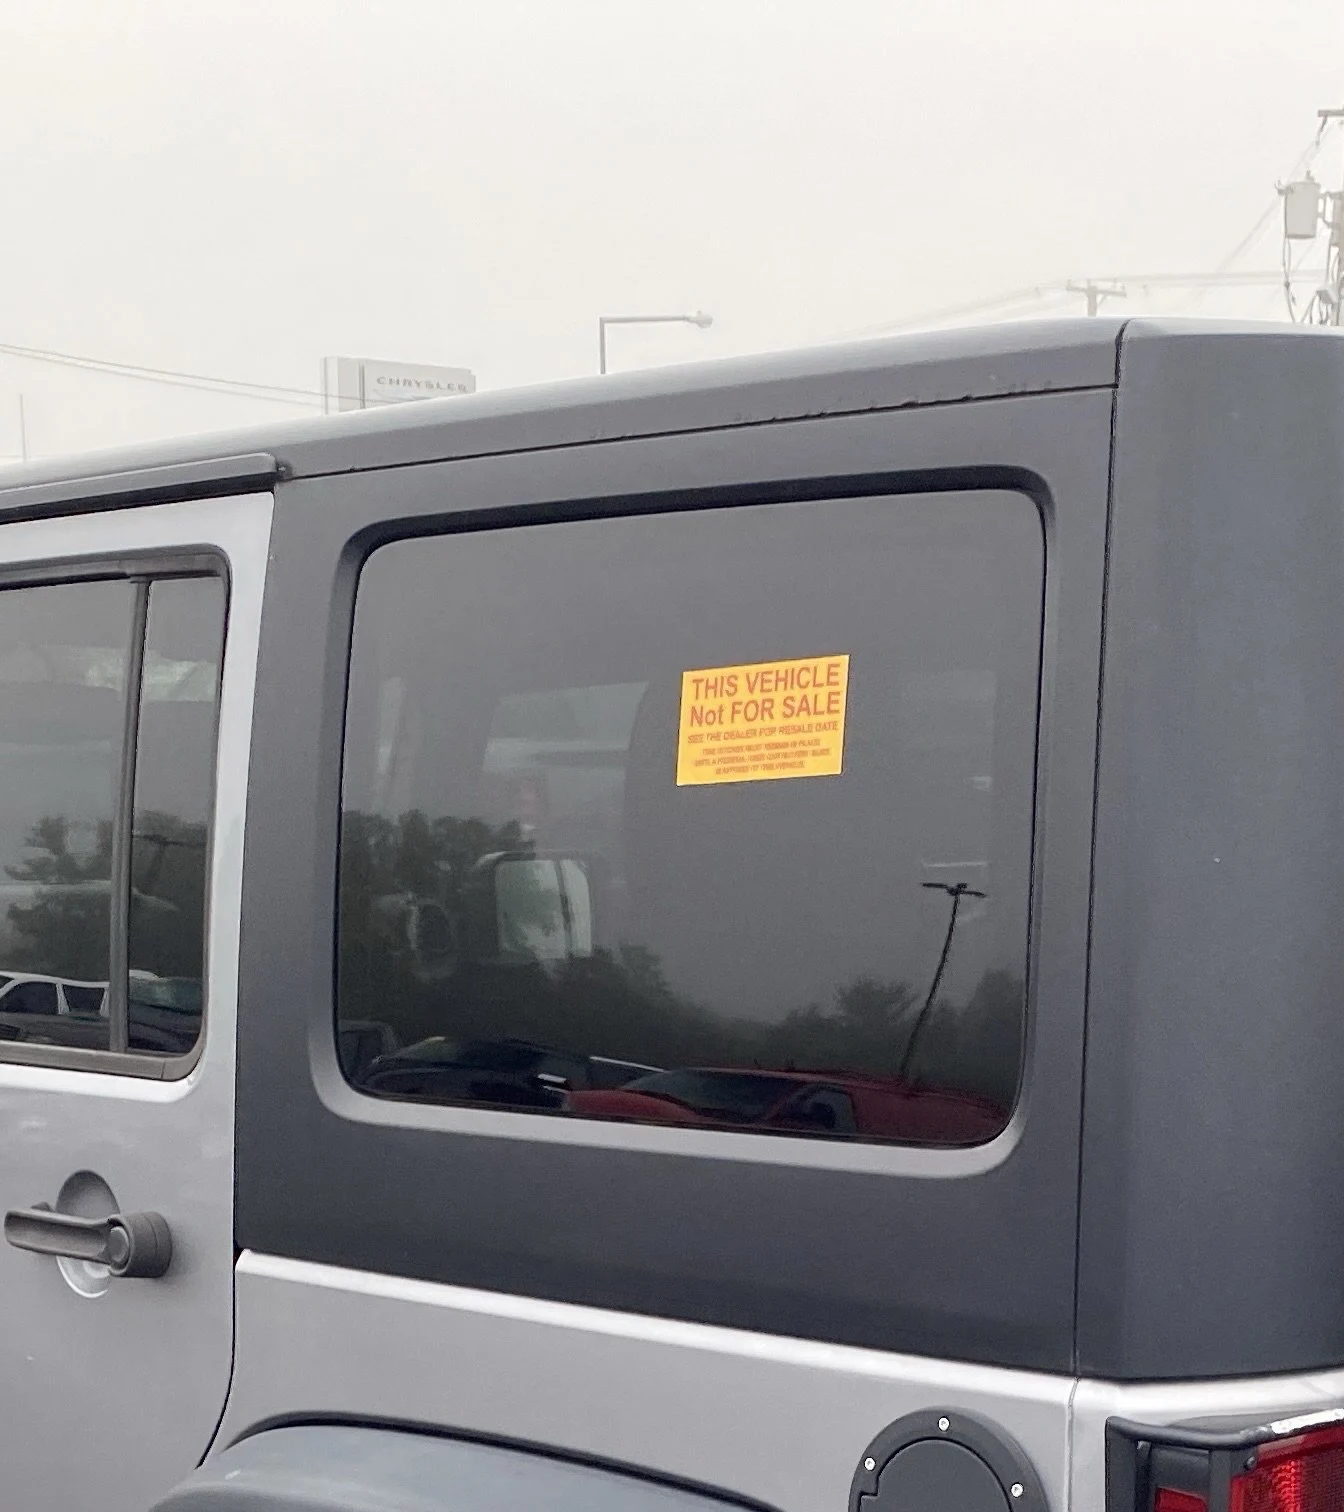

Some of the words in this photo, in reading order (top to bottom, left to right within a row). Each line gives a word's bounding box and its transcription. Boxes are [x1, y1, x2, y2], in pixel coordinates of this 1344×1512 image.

[376, 376, 468, 392] CHRYSLER
[692, 674, 739, 701] THIS
[746, 663, 841, 695] VEHICLE
[690, 703, 727, 728] Not
[730, 697, 775, 724] FOR
[782, 691, 842, 719] SALE
